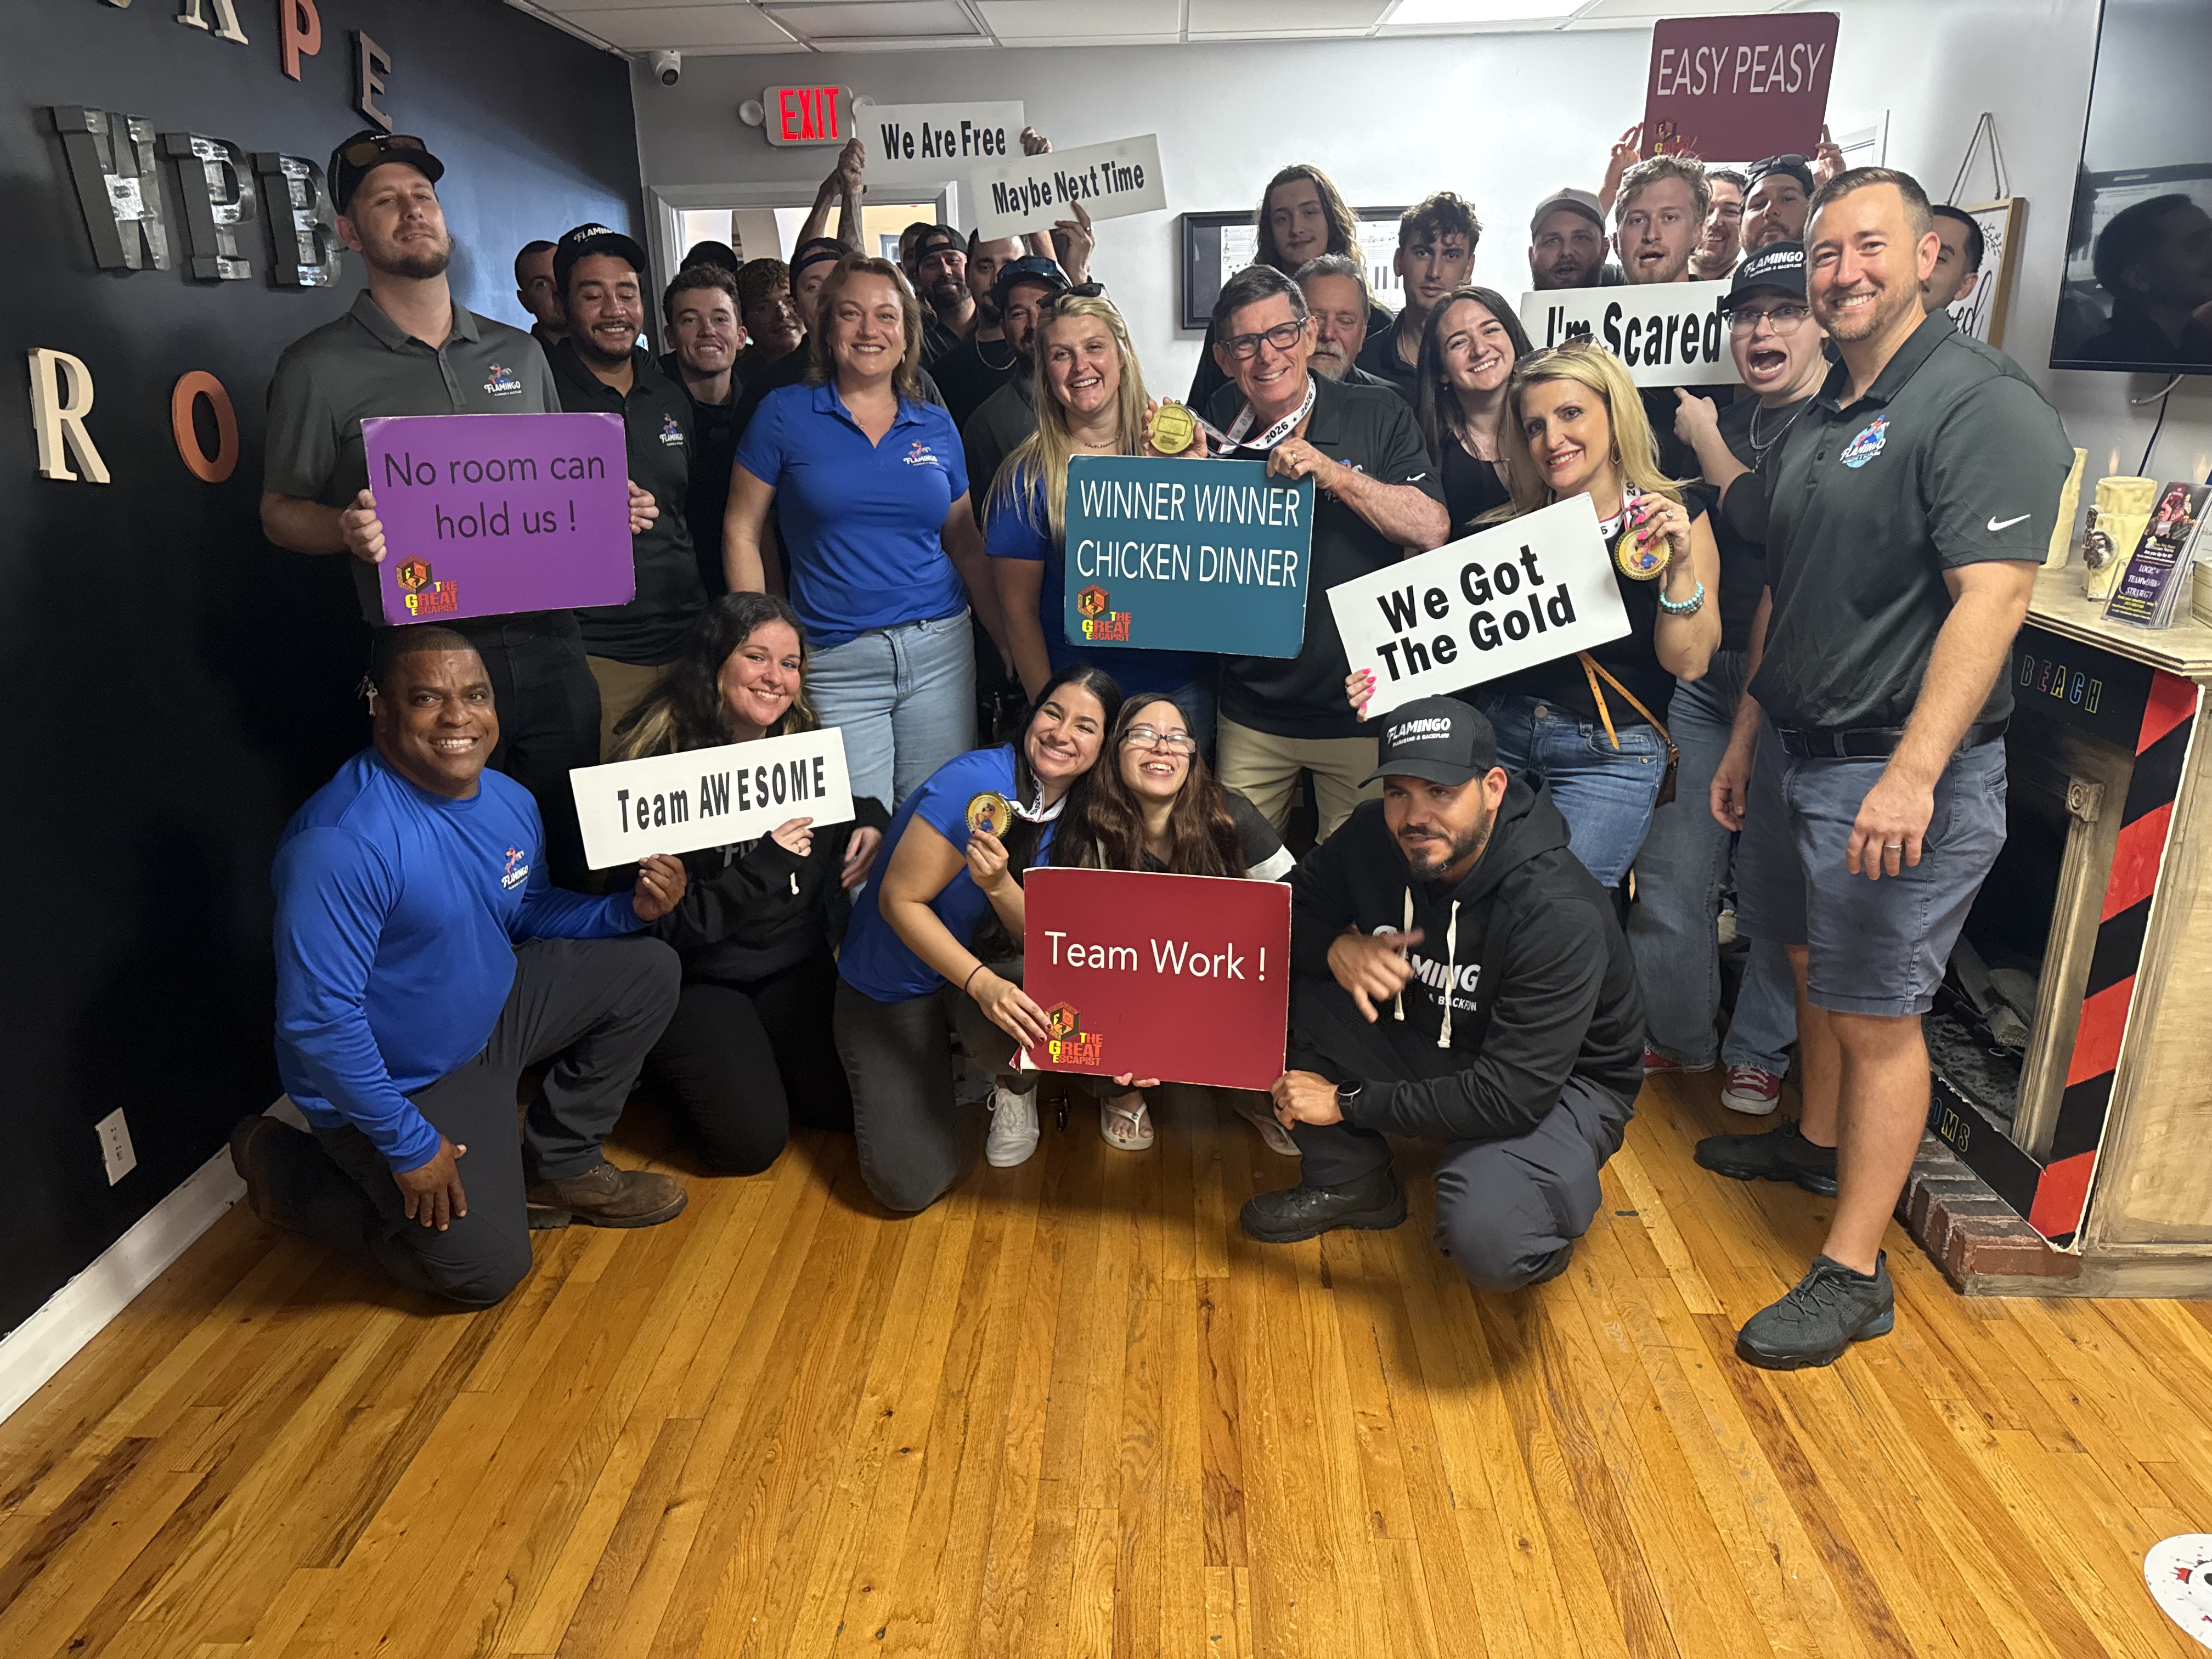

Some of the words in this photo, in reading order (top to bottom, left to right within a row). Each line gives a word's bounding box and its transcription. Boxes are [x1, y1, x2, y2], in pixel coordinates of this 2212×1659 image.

[1657, 46, 1734, 95] EASY
[1733, 43, 1825, 94] PEASY
[778, 87, 840, 141] EXIT
[881, 123, 915, 160] We
[922, 122, 956, 159] Are
[960, 120, 1006, 156] Free
[53, 105, 342, 287] WPB
[991, 177, 1052, 217] Maybe
[1053, 165, 1101, 203] Next
[1101, 161, 1145, 194] Time
[573, 227, 612, 243] FLAMIN
[1743, 251, 1804, 278] FLAMINGO
[1546, 306, 1592, 348] I'm
[1603, 295, 1724, 367] Scared
[483, 380, 521, 394] FLAMINGO
[659, 433, 684, 444] FLAMINGO
[1264, 421, 1289, 444] 2026
[385, 452, 436, 488] No
[449, 458, 537, 484] room
[550, 456, 605, 480] can
[902, 455, 938, 465] FLAMINGO
[1080, 480, 1186, 522] WINNER
[1194, 484, 1300, 527] WINNER
[435, 500, 510, 540] hold
[523, 511, 557, 534] us
[569, 500, 575, 532] !
[1077, 539, 1190, 582] CHICKEN
[1199, 545, 1298, 588] DINNER
[405, 590, 457, 608] GREAT
[434, 580, 458, 592] THE
[1376, 585, 1449, 635] We
[1460, 545, 1546, 607] Got
[411, 603, 459, 616] ESCAPIST
[1109, 611, 1132, 622] THE
[1081, 619, 1131, 634] GREAT
[1086, 632, 1131, 641] ESCAPIST
[1376, 632, 1458, 682] The
[1469, 583, 1577, 652] Gold
[2020, 654, 2102, 714] BEACH
[1386, 717, 1451, 746] FLAMINGO
[617, 789, 690, 833] Team
[699, 756, 826, 819] AWESOME
[501, 865, 528, 888] FLAMINGO
[1045, 931, 1138, 972] Team
[1150, 939, 1246, 980] Work
[1259, 947, 1266, 982] !
[1048, 1040, 1102, 1057] GREAT
[1079, 1032, 1104, 1045] THE
[1052, 1054, 1102, 1066] ESCAPIST
